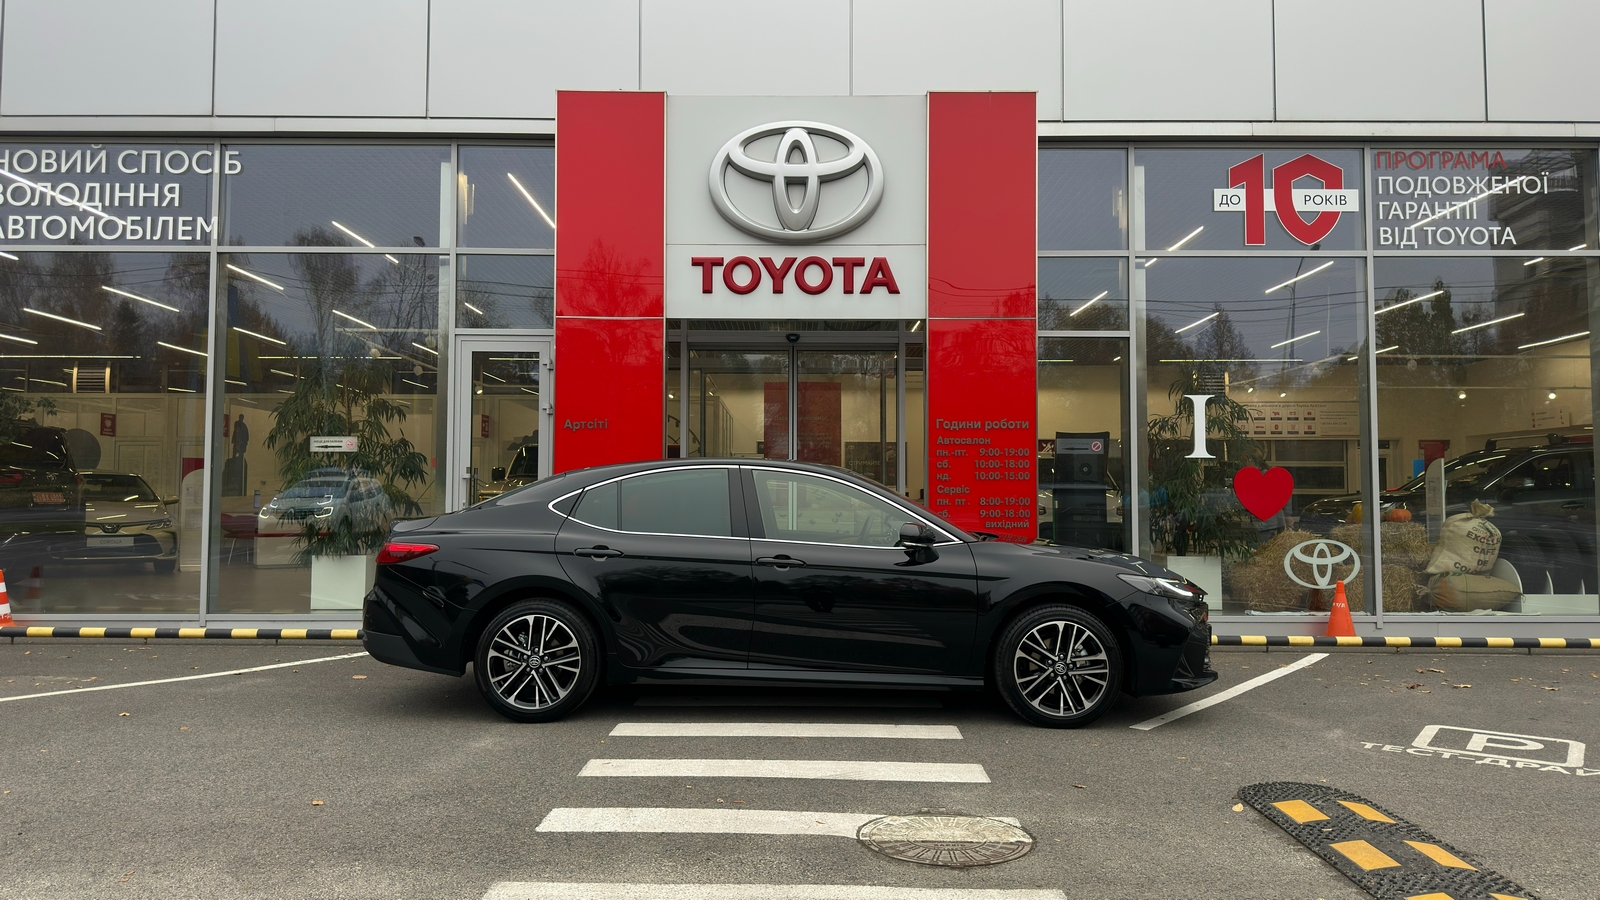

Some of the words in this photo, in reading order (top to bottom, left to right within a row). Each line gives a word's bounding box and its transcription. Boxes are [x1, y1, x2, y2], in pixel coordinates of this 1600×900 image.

[117, 150, 243, 175] СПОСІБ
[1376, 151, 1507, 169] ПРОГРАМА
[1378, 171, 1550, 198] ПОДОВЖЕНОЇ
[0, 182, 180, 211] ОЛОДІННЯ
[1219, 194, 1241, 207] ДО
[1228, 153, 1344, 246] 10
[1304, 194, 1348, 206] РОКІВ
[1379, 197, 1478, 220] ГАРАНТІЇ
[0, 215, 219, 241] ВТОМОБІЛЕМ
[1380, 227, 1418, 249] ВІД
[1423, 227, 1517, 245] TOYOTA
[691, 256, 900, 295] TOYOTA
[564, 418, 608, 432] Артсіті
[936, 419, 981, 431] Години
[985, 419, 1029, 431] роботи
[1183, 394, 1216, 459] I
[937, 436, 991, 445] Автосалон
[979, 448, 1030, 457] 9:00-19:00
[936, 460, 951, 468] сб.
[974, 460, 1030, 468] 10:00-18:00
[936, 473, 951, 481] нд.
[974, 472, 1030, 480] 10:00-15:00
[937, 485, 970, 495] Сервіс
[980, 498, 1030, 506] 8:00-19:00
[980, 509, 1030, 518] 9:00-18:00
[985, 520, 1030, 529] вихідний
[1466, 733, 1545, 751] P
